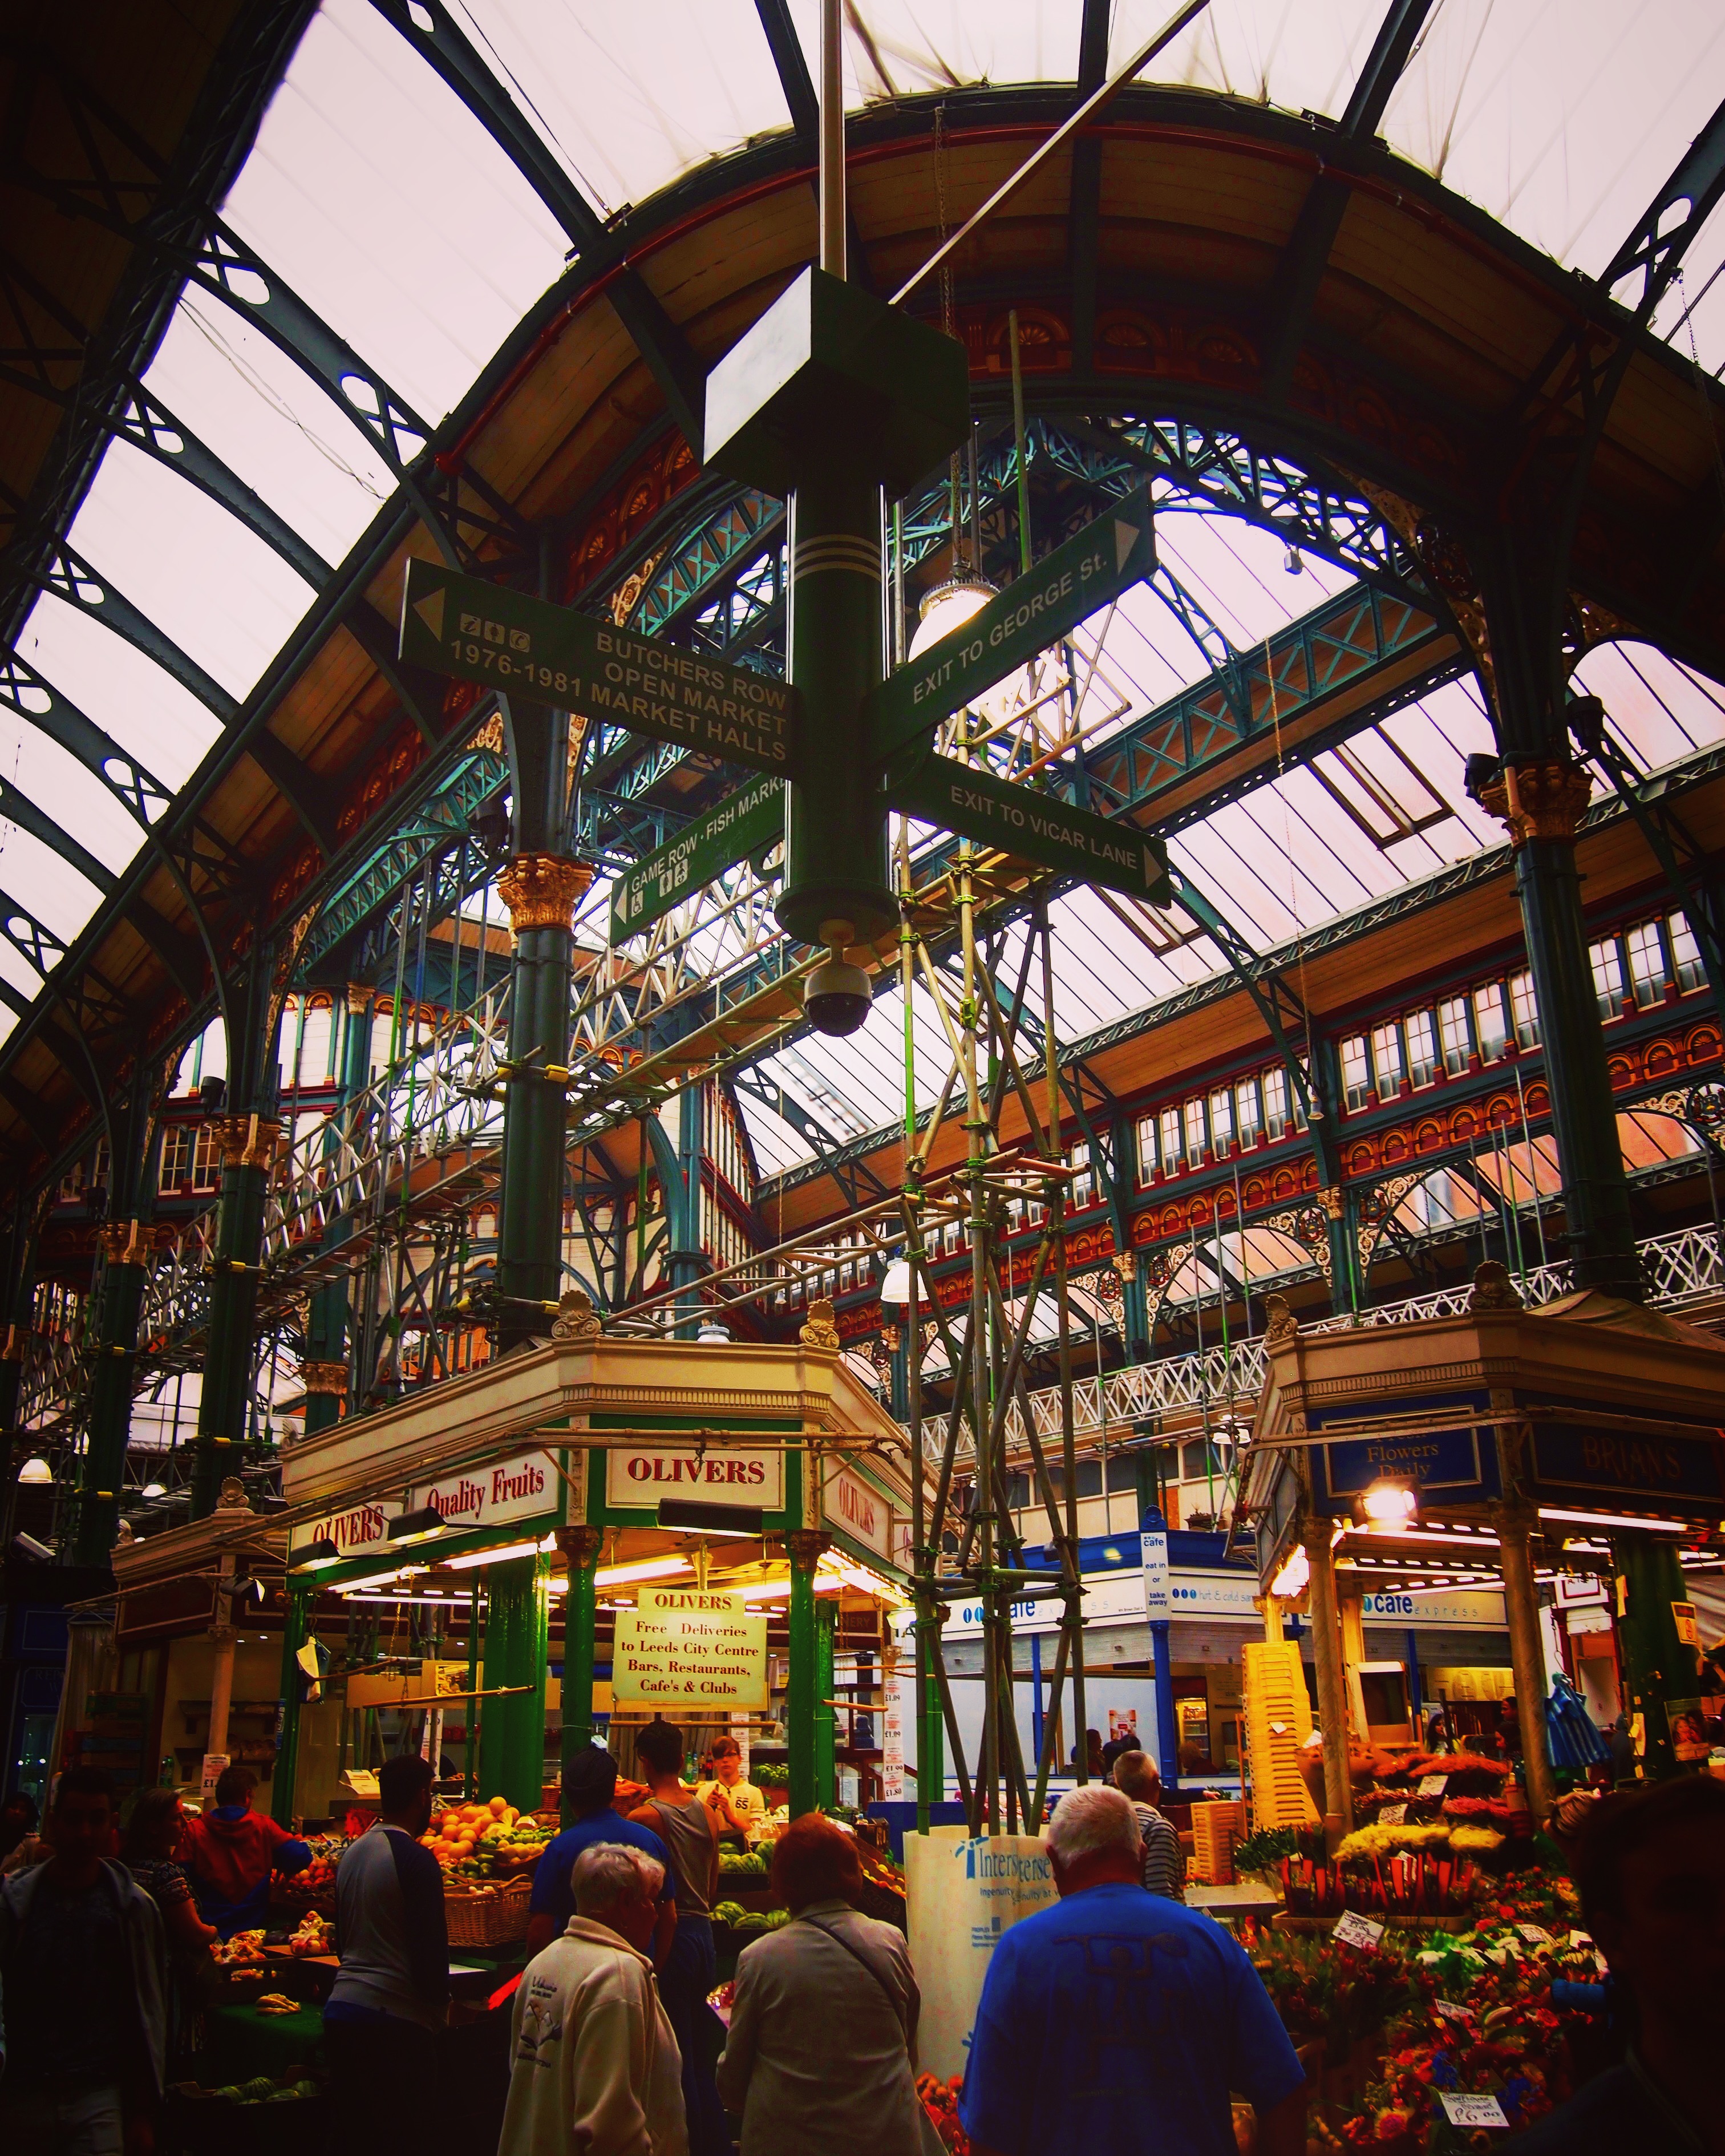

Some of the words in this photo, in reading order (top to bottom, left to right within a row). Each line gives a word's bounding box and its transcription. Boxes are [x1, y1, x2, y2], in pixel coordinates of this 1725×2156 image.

[914, 659, 953, 705] EXIT
[959, 639, 983, 669] TO
[990, 572, 1073, 646] GEORGE
[597, 632, 725, 690] BUTCHERS
[732, 677, 785, 711] ROW
[451, 640, 581, 697] 1976-1981
[591, 683, 700, 733] MARKET
[707, 719, 785, 761] HALLS
[605, 662, 676, 701] OPEN
[684, 686, 787, 735] MARKET
[951, 785, 994, 816] EXIT
[999, 803, 1025, 827] TO
[1029, 814, 1086, 851] VICAR
[1090, 838, 1137, 870] LANE
[631, 856, 665, 893] GAME
[669, 833, 698, 867] ROW
[707, 806, 735, 840] FISH
[1367, 1443, 1439, 1463] Flowers
[627, 1457, 765, 1484] OLIVERS
[427, 1481, 486, 1519] Quality
[491, 1463, 545, 1505] Fruits
[839, 1477, 874, 1538] OLIVERS
[313, 1504, 385, 1550] OLIVERS
[1144, 1538, 1164, 1547] cafe
[655, 1593, 732, 1611] OLIVERS
[1414, 1605, 1479, 1617] express
[636, 1621, 667, 1633] Free
[682, 1623, 747, 1637] Deliveries
[621, 1641, 634, 1652] to
[640, 1640, 678, 1653] Leeds
[684, 1643, 710, 1657] City
[715, 1644, 759, 1657] Centre
[628, 1659, 663, 1673] Bars,
[669, 1661, 751, 1676] Restaurants,
[640, 1679, 679, 1693] Cafe's
[684, 1680, 695, 1693] &
[700, 1681, 738, 1694] Clubs
[735, 1799, 748, 1810] 65
